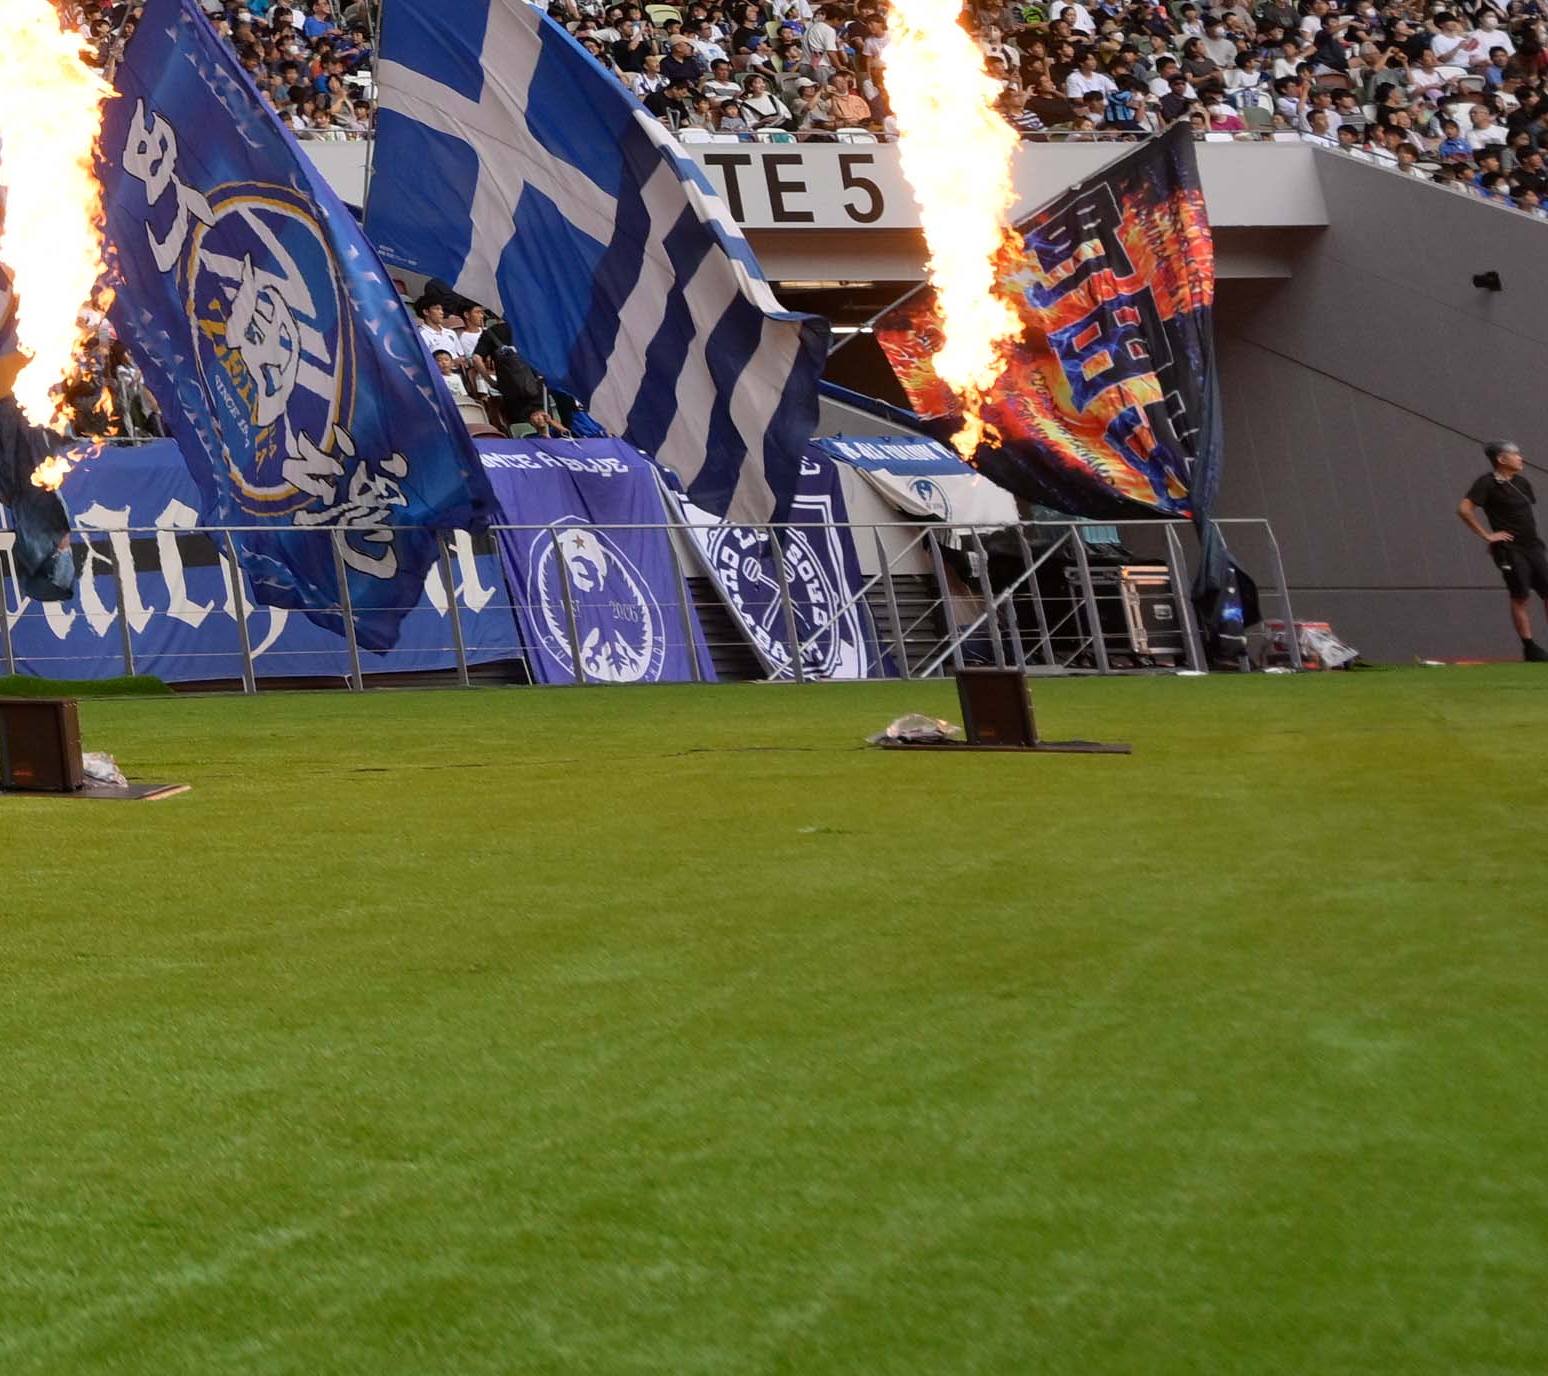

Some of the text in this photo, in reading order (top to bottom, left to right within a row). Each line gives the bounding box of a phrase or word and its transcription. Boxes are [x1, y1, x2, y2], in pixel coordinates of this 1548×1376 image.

[702, 152, 886, 224] TE 5
[560, 456, 630, 477] BLUE
